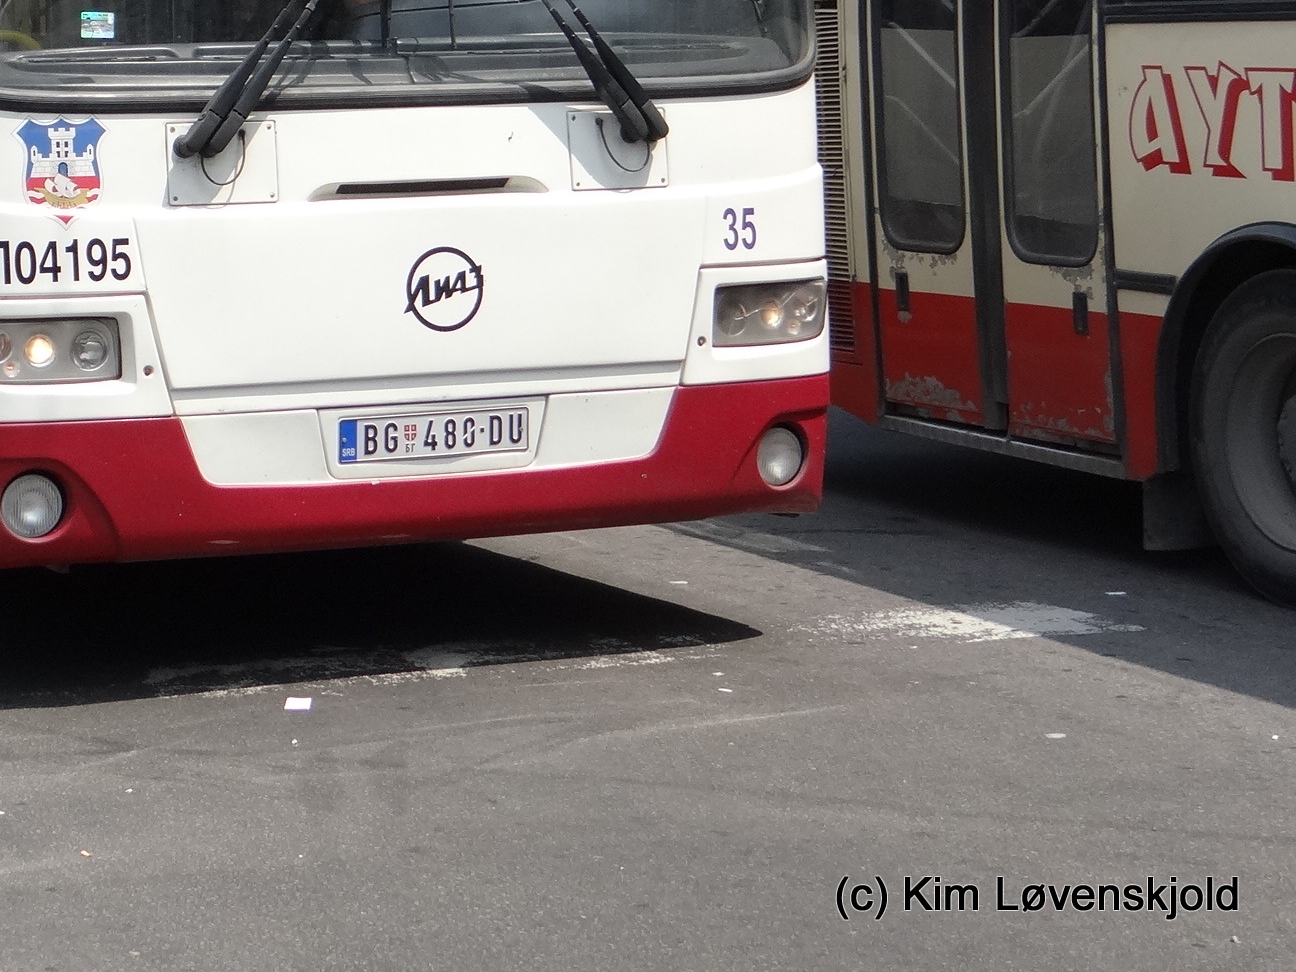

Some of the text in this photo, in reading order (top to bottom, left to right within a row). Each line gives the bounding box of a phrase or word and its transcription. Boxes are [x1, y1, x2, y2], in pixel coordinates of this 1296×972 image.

[722, 207, 757, 251] 35
[341, 446, 355, 457] SRB
[363, 422, 399, 456] BG
